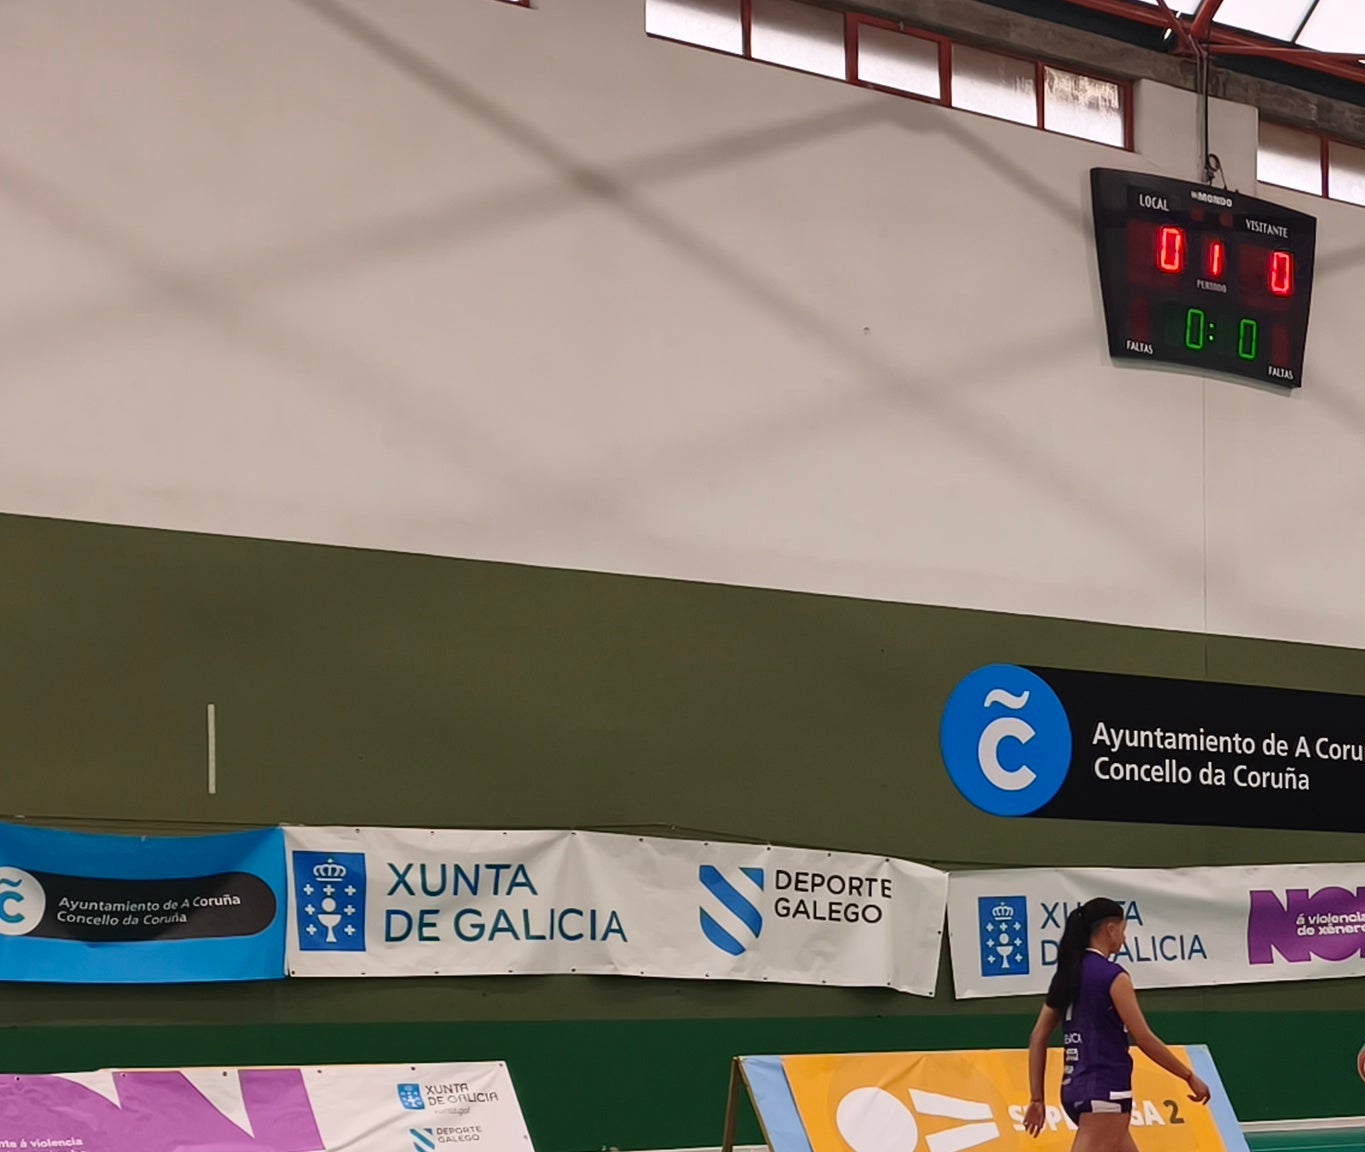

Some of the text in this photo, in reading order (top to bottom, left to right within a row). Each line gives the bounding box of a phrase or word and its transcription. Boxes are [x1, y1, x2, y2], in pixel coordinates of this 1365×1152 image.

[1139, 194, 1169, 212] LOCAL
[1245, 219, 1288, 238] VISITANTE
[1159, 226, 1183, 271] 0
[1269, 250, 1292, 294] 0
[1126, 340, 1153, 355] FALTAS
[1268, 366, 1293, 379] FALTAS
[1092, 721, 1256, 756] Ayuntamiento
[1262, 732, 1289, 757] de
[1294, 735, 1311, 758] A
[1094, 757, 1310, 791] Concello da Coruña
[387, 862, 538, 897] XUNTA
[775, 869, 892, 899] DEPORTE
[58, 894, 241, 912] Ayuntamiento de A Coruña
[775, 898, 882, 924] GALEGO
[57, 911, 187, 926] Concello da Coruña
[385, 908, 628, 943] DE GALICIA
[1297, 926, 1315, 936] de
[1113, 934, 1207, 964] ALICIA
[425, 1083, 469, 1095] XUNTA
[428, 1092, 499, 1106] DE GALICIA
[1163, 1100, 1185, 1124] 2
[436, 1126, 482, 1135] DEPORTE
[438, 1134, 480, 1143] GALEGO
[30, 1137, 83, 1148] violencia
